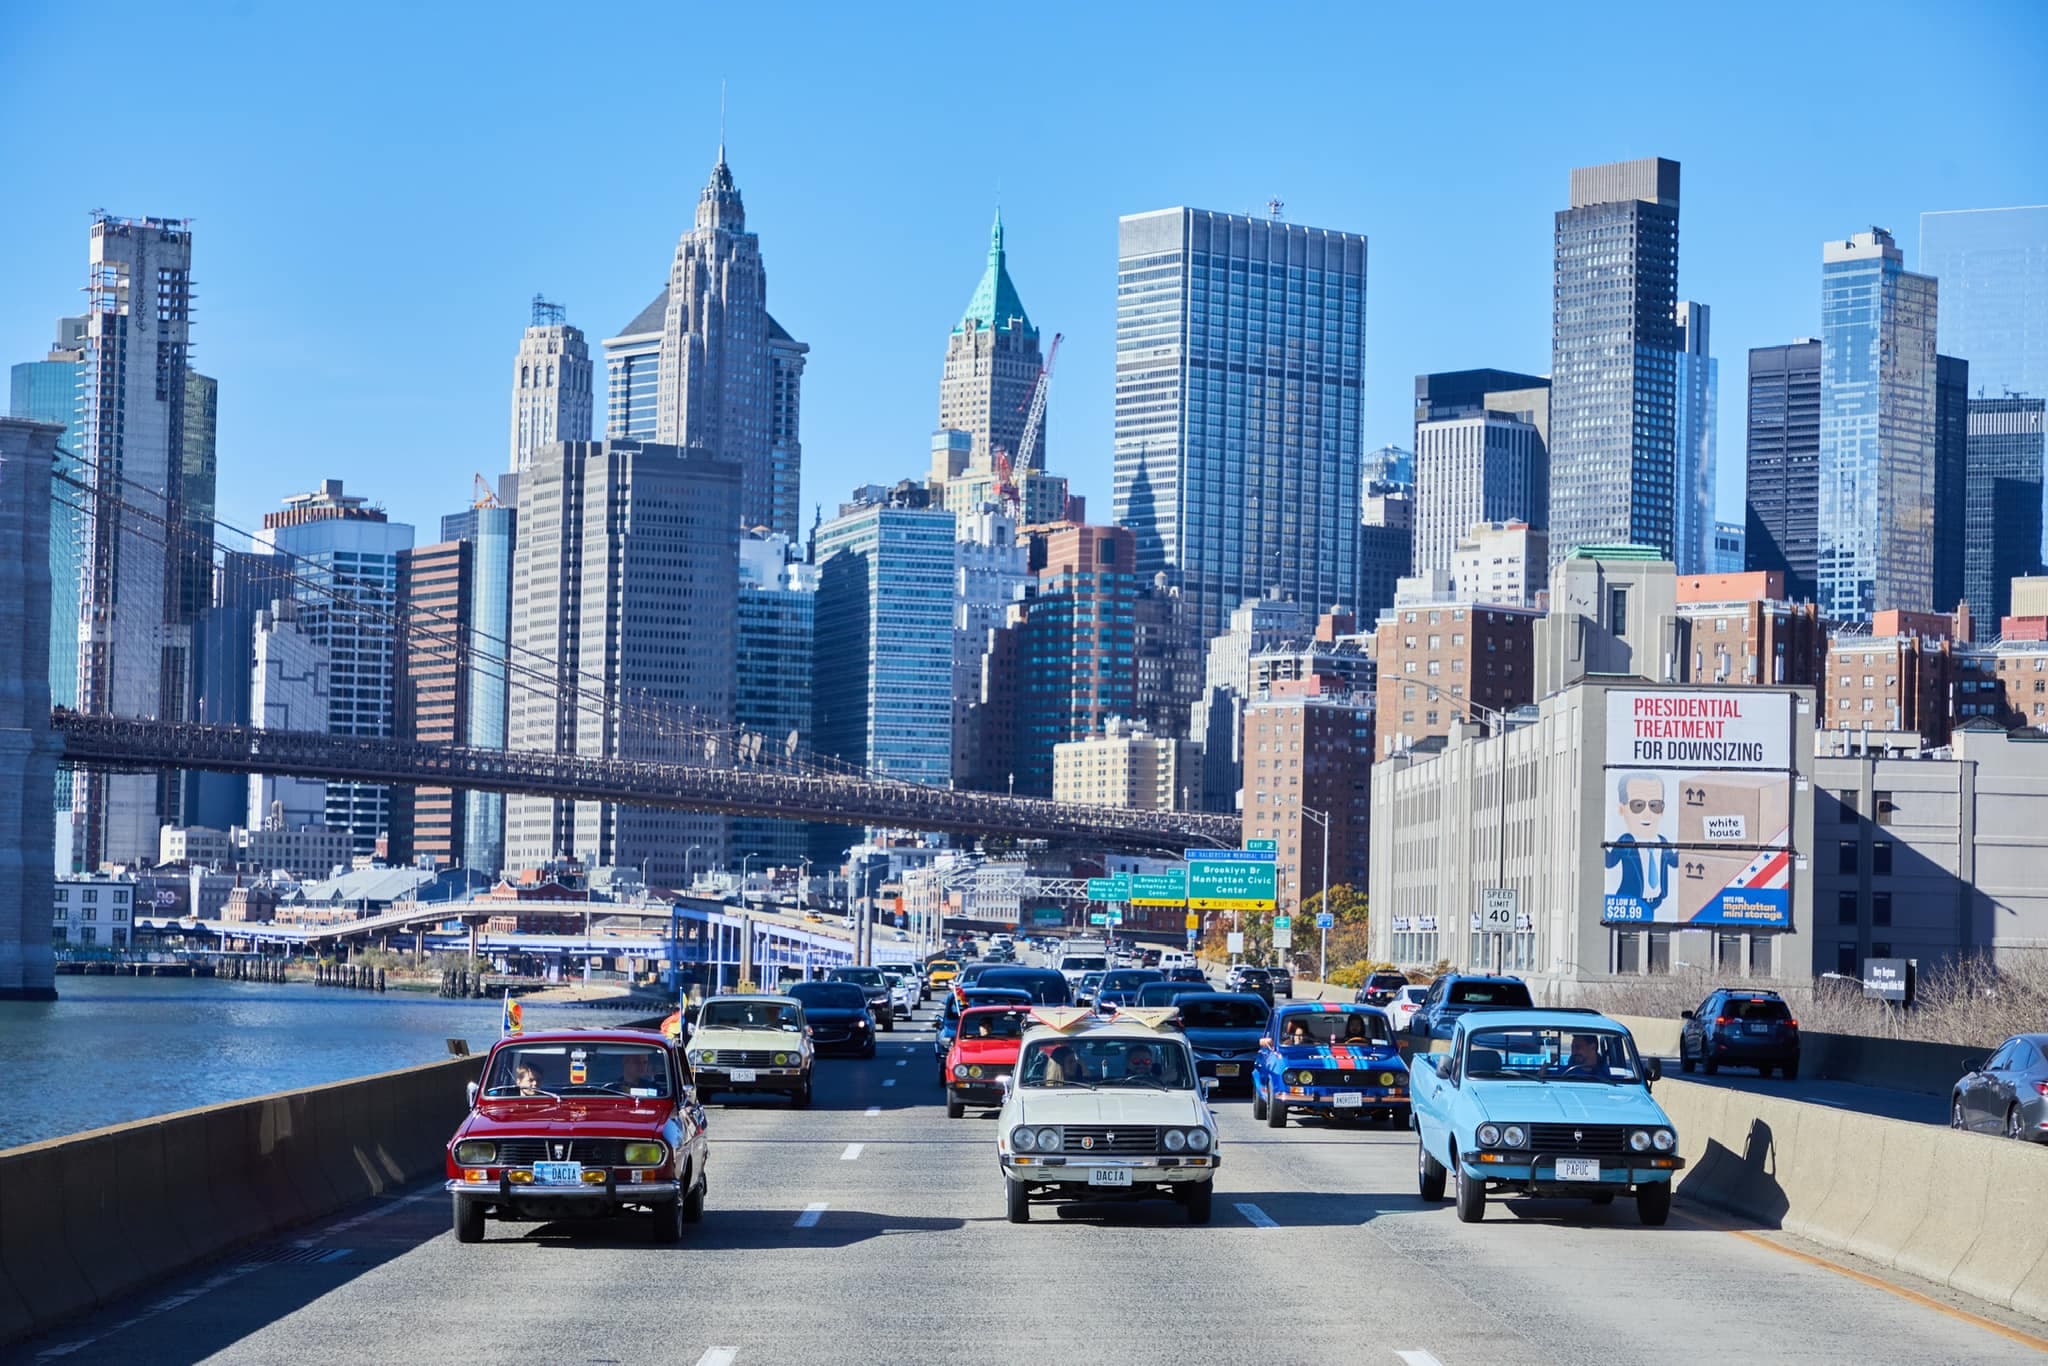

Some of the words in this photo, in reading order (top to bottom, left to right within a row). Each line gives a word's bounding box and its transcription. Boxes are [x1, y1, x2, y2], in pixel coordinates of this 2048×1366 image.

[1634, 698, 1742, 717] PRESIDENTIAL
[1634, 720, 1725, 738] TREATMENT
[1634, 741, 1662, 760] FOR
[1668, 741, 1763, 761] DOWNSIZING
[1709, 817, 1739, 827] white
[1709, 829, 1741, 837] house
[1266, 842, 1274, 850] 2
[1203, 866, 1246, 875] Brooklyn
[1249, 866, 1261, 875] Br
[1192, 875, 1244, 884] Manhattan
[1247, 876, 1272, 885] Civic
[1216, 886, 1248, 894] Center
[1487, 891, 1513, 899] SPEED
[1607, 898, 1615, 906] AS
[1616, 898, 1628, 906] LOW
[1629, 898, 1637, 906] AS
[1723, 901, 1776, 911] manhattan
[1490, 910, 1510, 922] 40
[1607, 906, 1642, 919] $29.99
[552, 1168, 577, 1180] DACIA
[1567, 1164, 1589, 1176] PAPUC
[1096, 1170, 1124, 1181] DACIA
